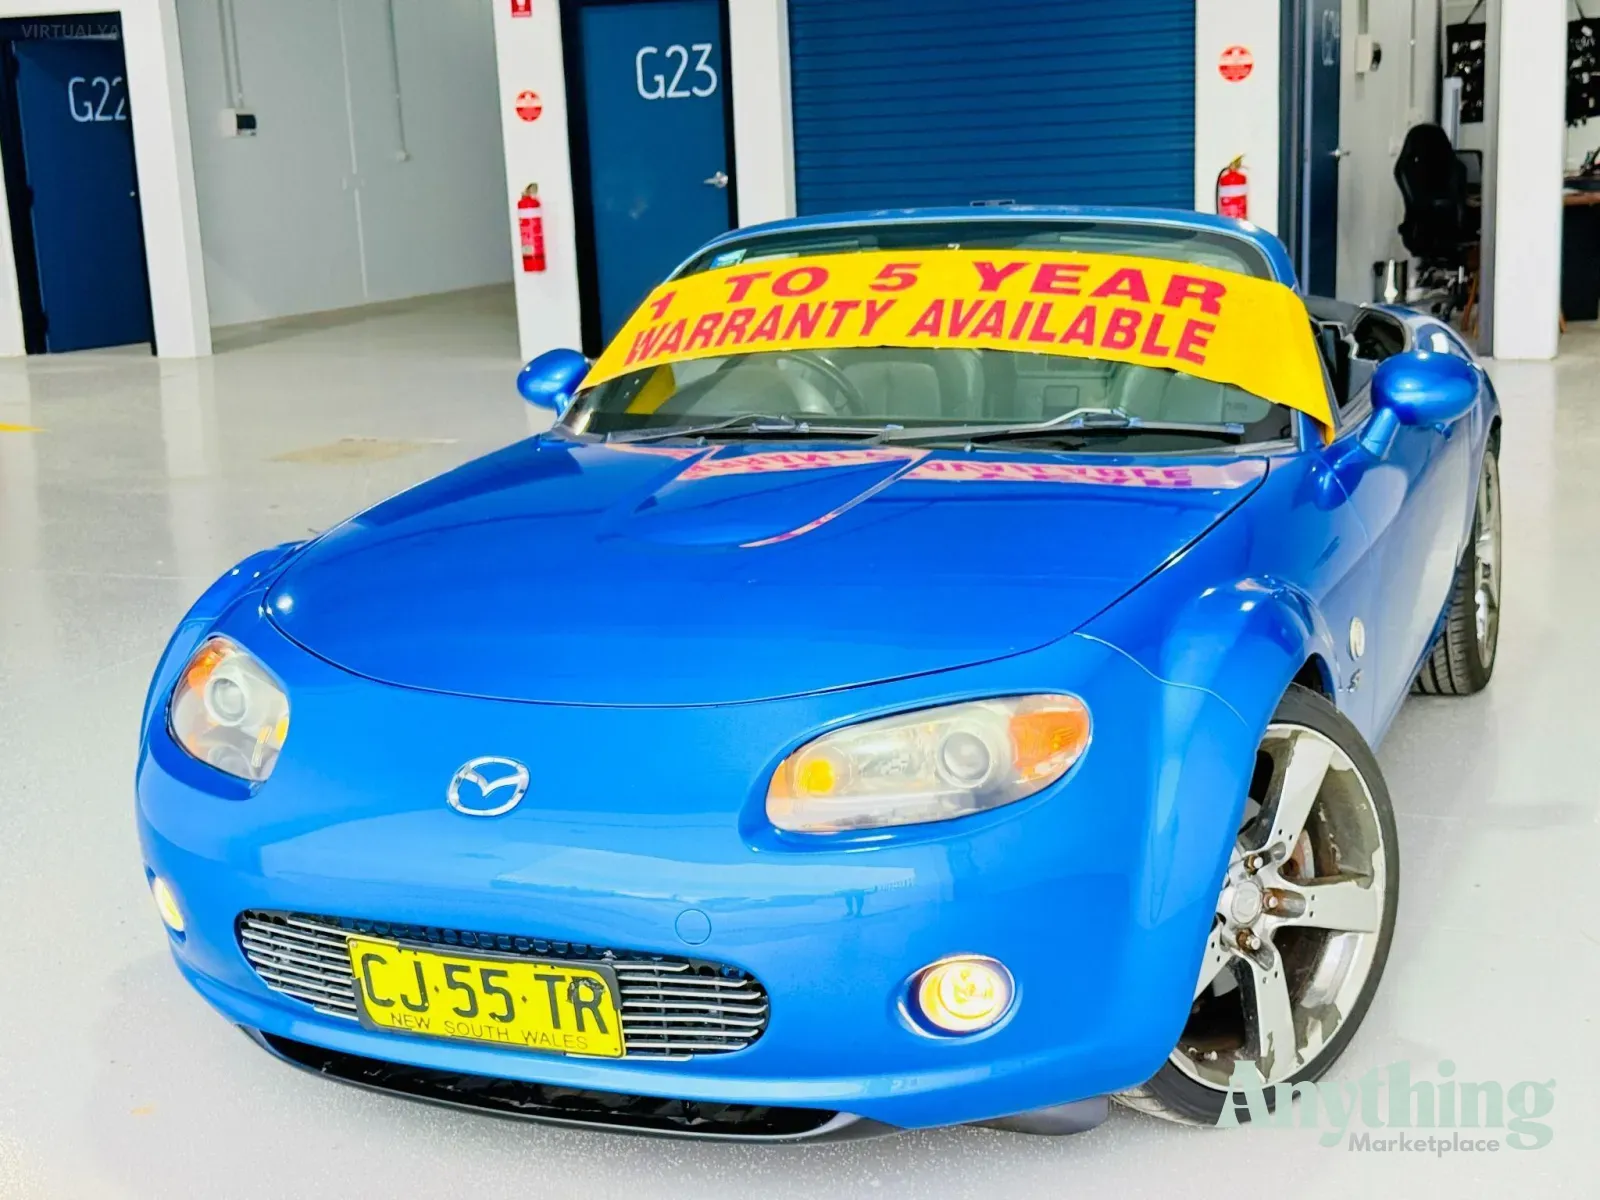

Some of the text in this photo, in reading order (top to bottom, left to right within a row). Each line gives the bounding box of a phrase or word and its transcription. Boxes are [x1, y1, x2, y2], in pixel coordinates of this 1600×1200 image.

[635, 43, 718, 100] G23
[650, 261, 1227, 321] 1 TO 5 YEAR
[623, 298, 1216, 367] WARRANTY AVAILABLE
[391, 1012, 588, 1050] NEW SOUTH WALES
